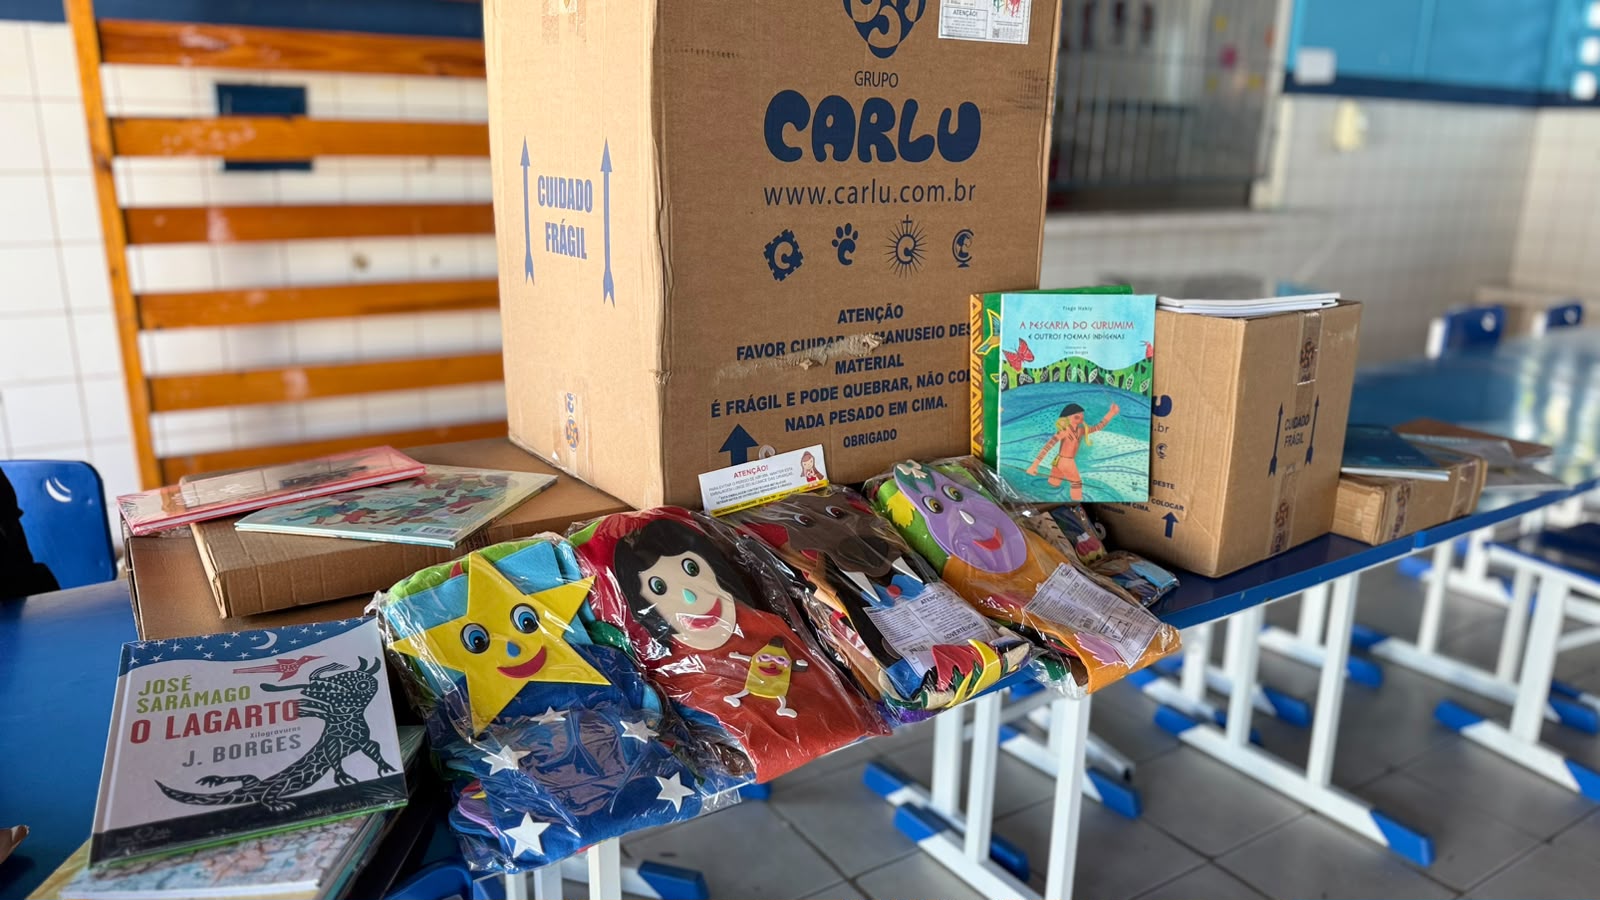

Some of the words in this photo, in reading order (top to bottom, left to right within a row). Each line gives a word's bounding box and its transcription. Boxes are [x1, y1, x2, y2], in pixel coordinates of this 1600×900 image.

[854, 70, 899, 88] GRUPO
[764, 89, 981, 163] CARLU
[537, 175, 593, 213] CUIDADO
[764, 178, 976, 206] www.carlu.com.br
[545, 219, 588, 260] FRÁGIL
[837, 303, 904, 324] ATENÇÃO
[1020, 321, 1026, 329] A
[1029, 321, 1069, 330] PESCARIA
[1073, 321, 1088, 330] DO
[1091, 321, 1134, 330] CURUMIM
[1092, 331, 1125, 340] INDÍGENAS
[736, 341, 786, 361] FAVOR
[949, 322, 970, 338] DES
[835, 354, 904, 375] MATERIAL
[711, 399, 721, 418] É
[726, 394, 782, 416] FRÁGIL
[786, 391, 796, 407] E
[800, 386, 839, 404] PODE
[843, 377, 913, 399] QUEBRAR,
[916, 371, 944, 388] NÃO
[785, 413, 826, 432] NADA
[829, 404, 885, 425] PESADO
[888, 401, 908, 416] EM
[912, 395, 948, 412] CIMA.
[1285, 414, 1310, 431] CUIDADO
[843, 429, 897, 448] OBRIGADO
[1284, 431, 1304, 448] FRÁGIL
[733, 464, 769, 479] ATENÇÃO!
[1152, 480, 1175, 490] DESTE
[1151, 499, 1184, 511] COLOCAR
[138, 675, 192, 696] JOSÉ
[136, 685, 250, 713] SARAMAGO
[130, 719, 151, 744] O
[165, 699, 300, 740] LAGARTO
[250, 726, 301, 738] Xilogravuras
[182, 750, 203, 767] J.
[213, 734, 301, 763] BORGES
